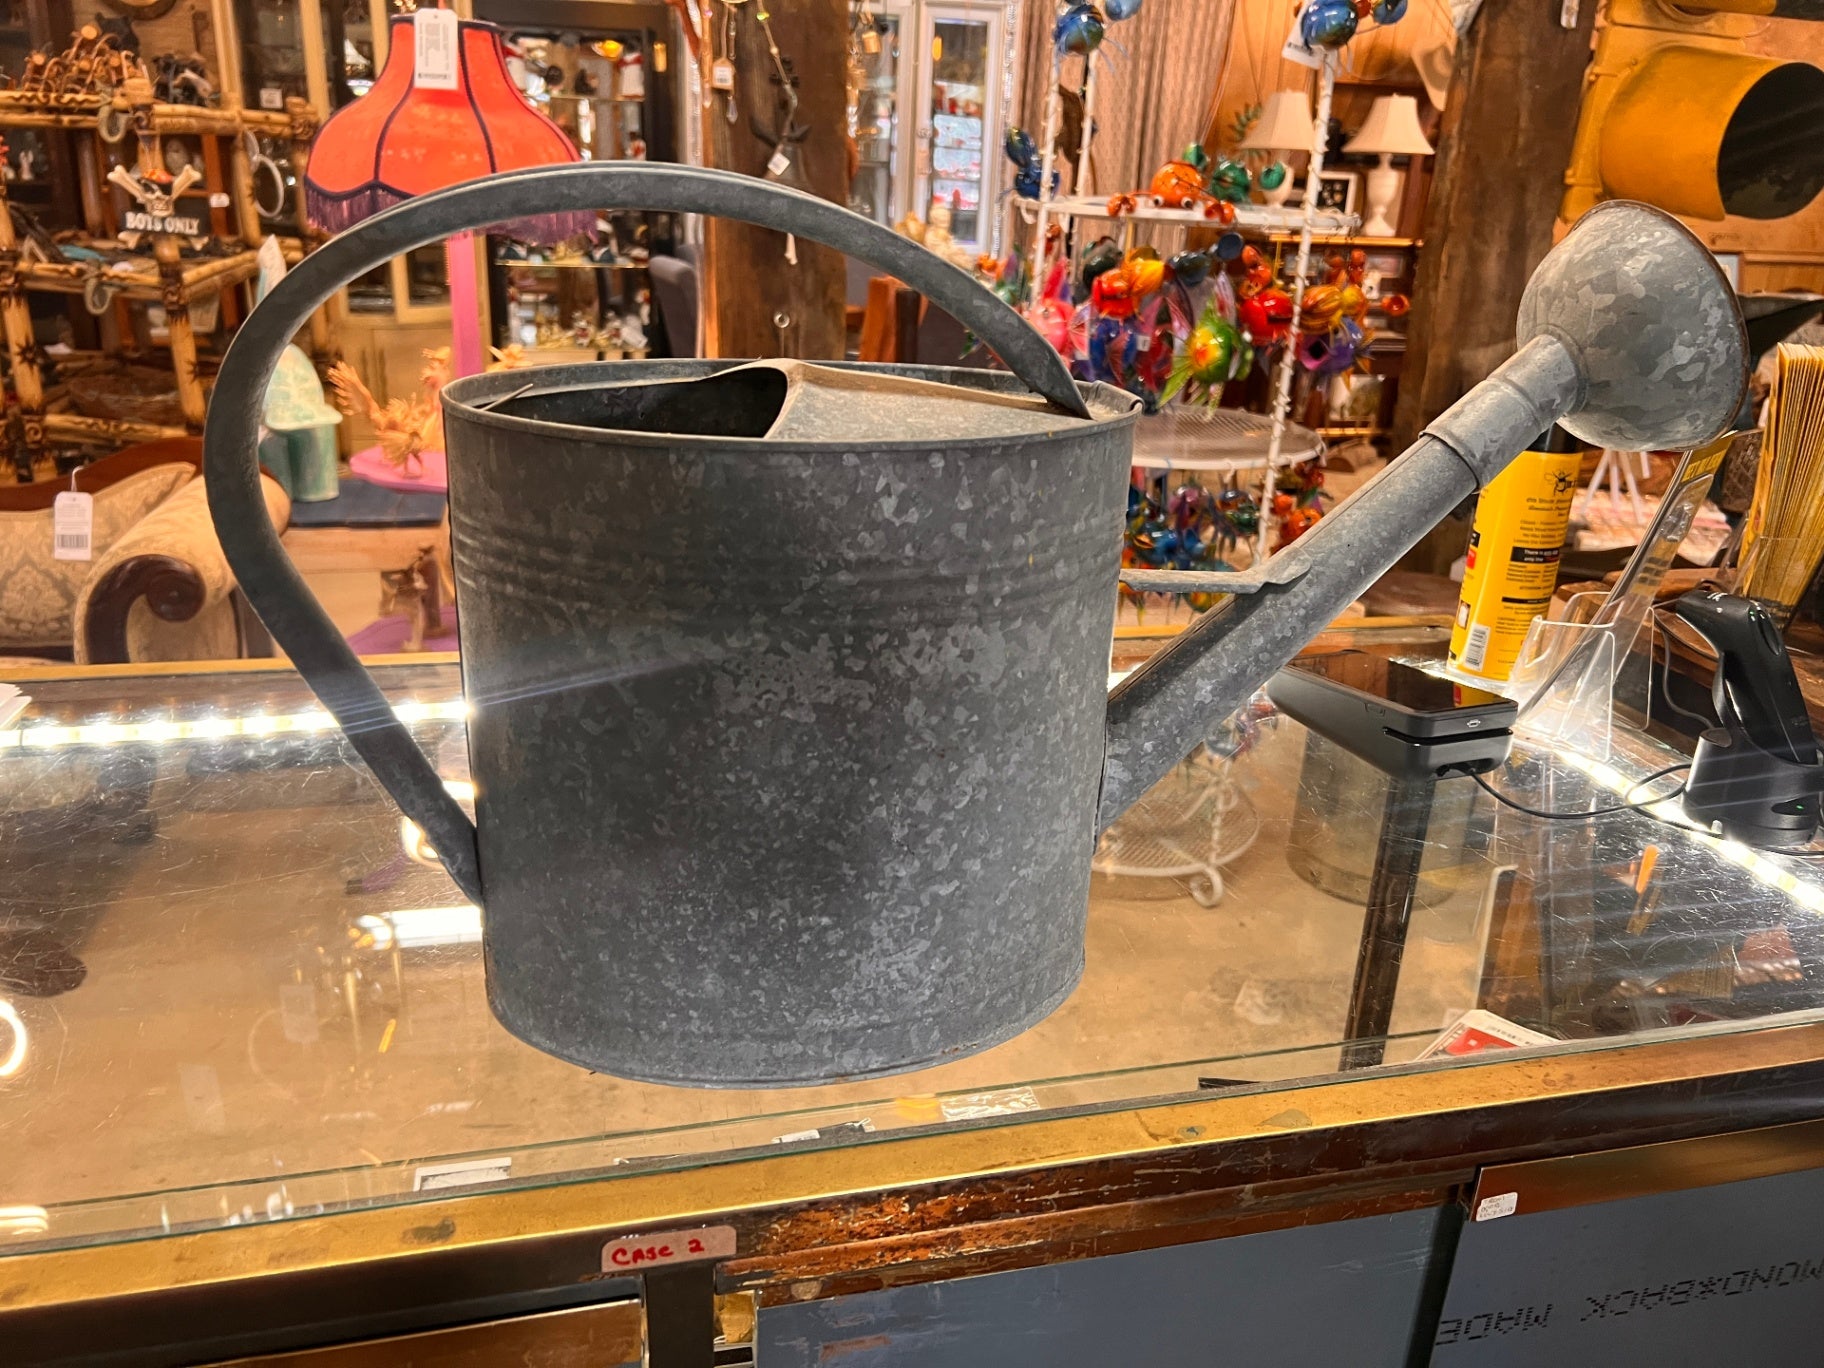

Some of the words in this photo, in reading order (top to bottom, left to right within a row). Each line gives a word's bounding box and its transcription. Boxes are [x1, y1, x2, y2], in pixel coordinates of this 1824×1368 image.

[125, 211, 162, 231] BOYS
[164, 217, 199, 235] ONLY
[688, 1238, 705, 1253] 2
[1435, 1303, 1553, 1346] MADE
